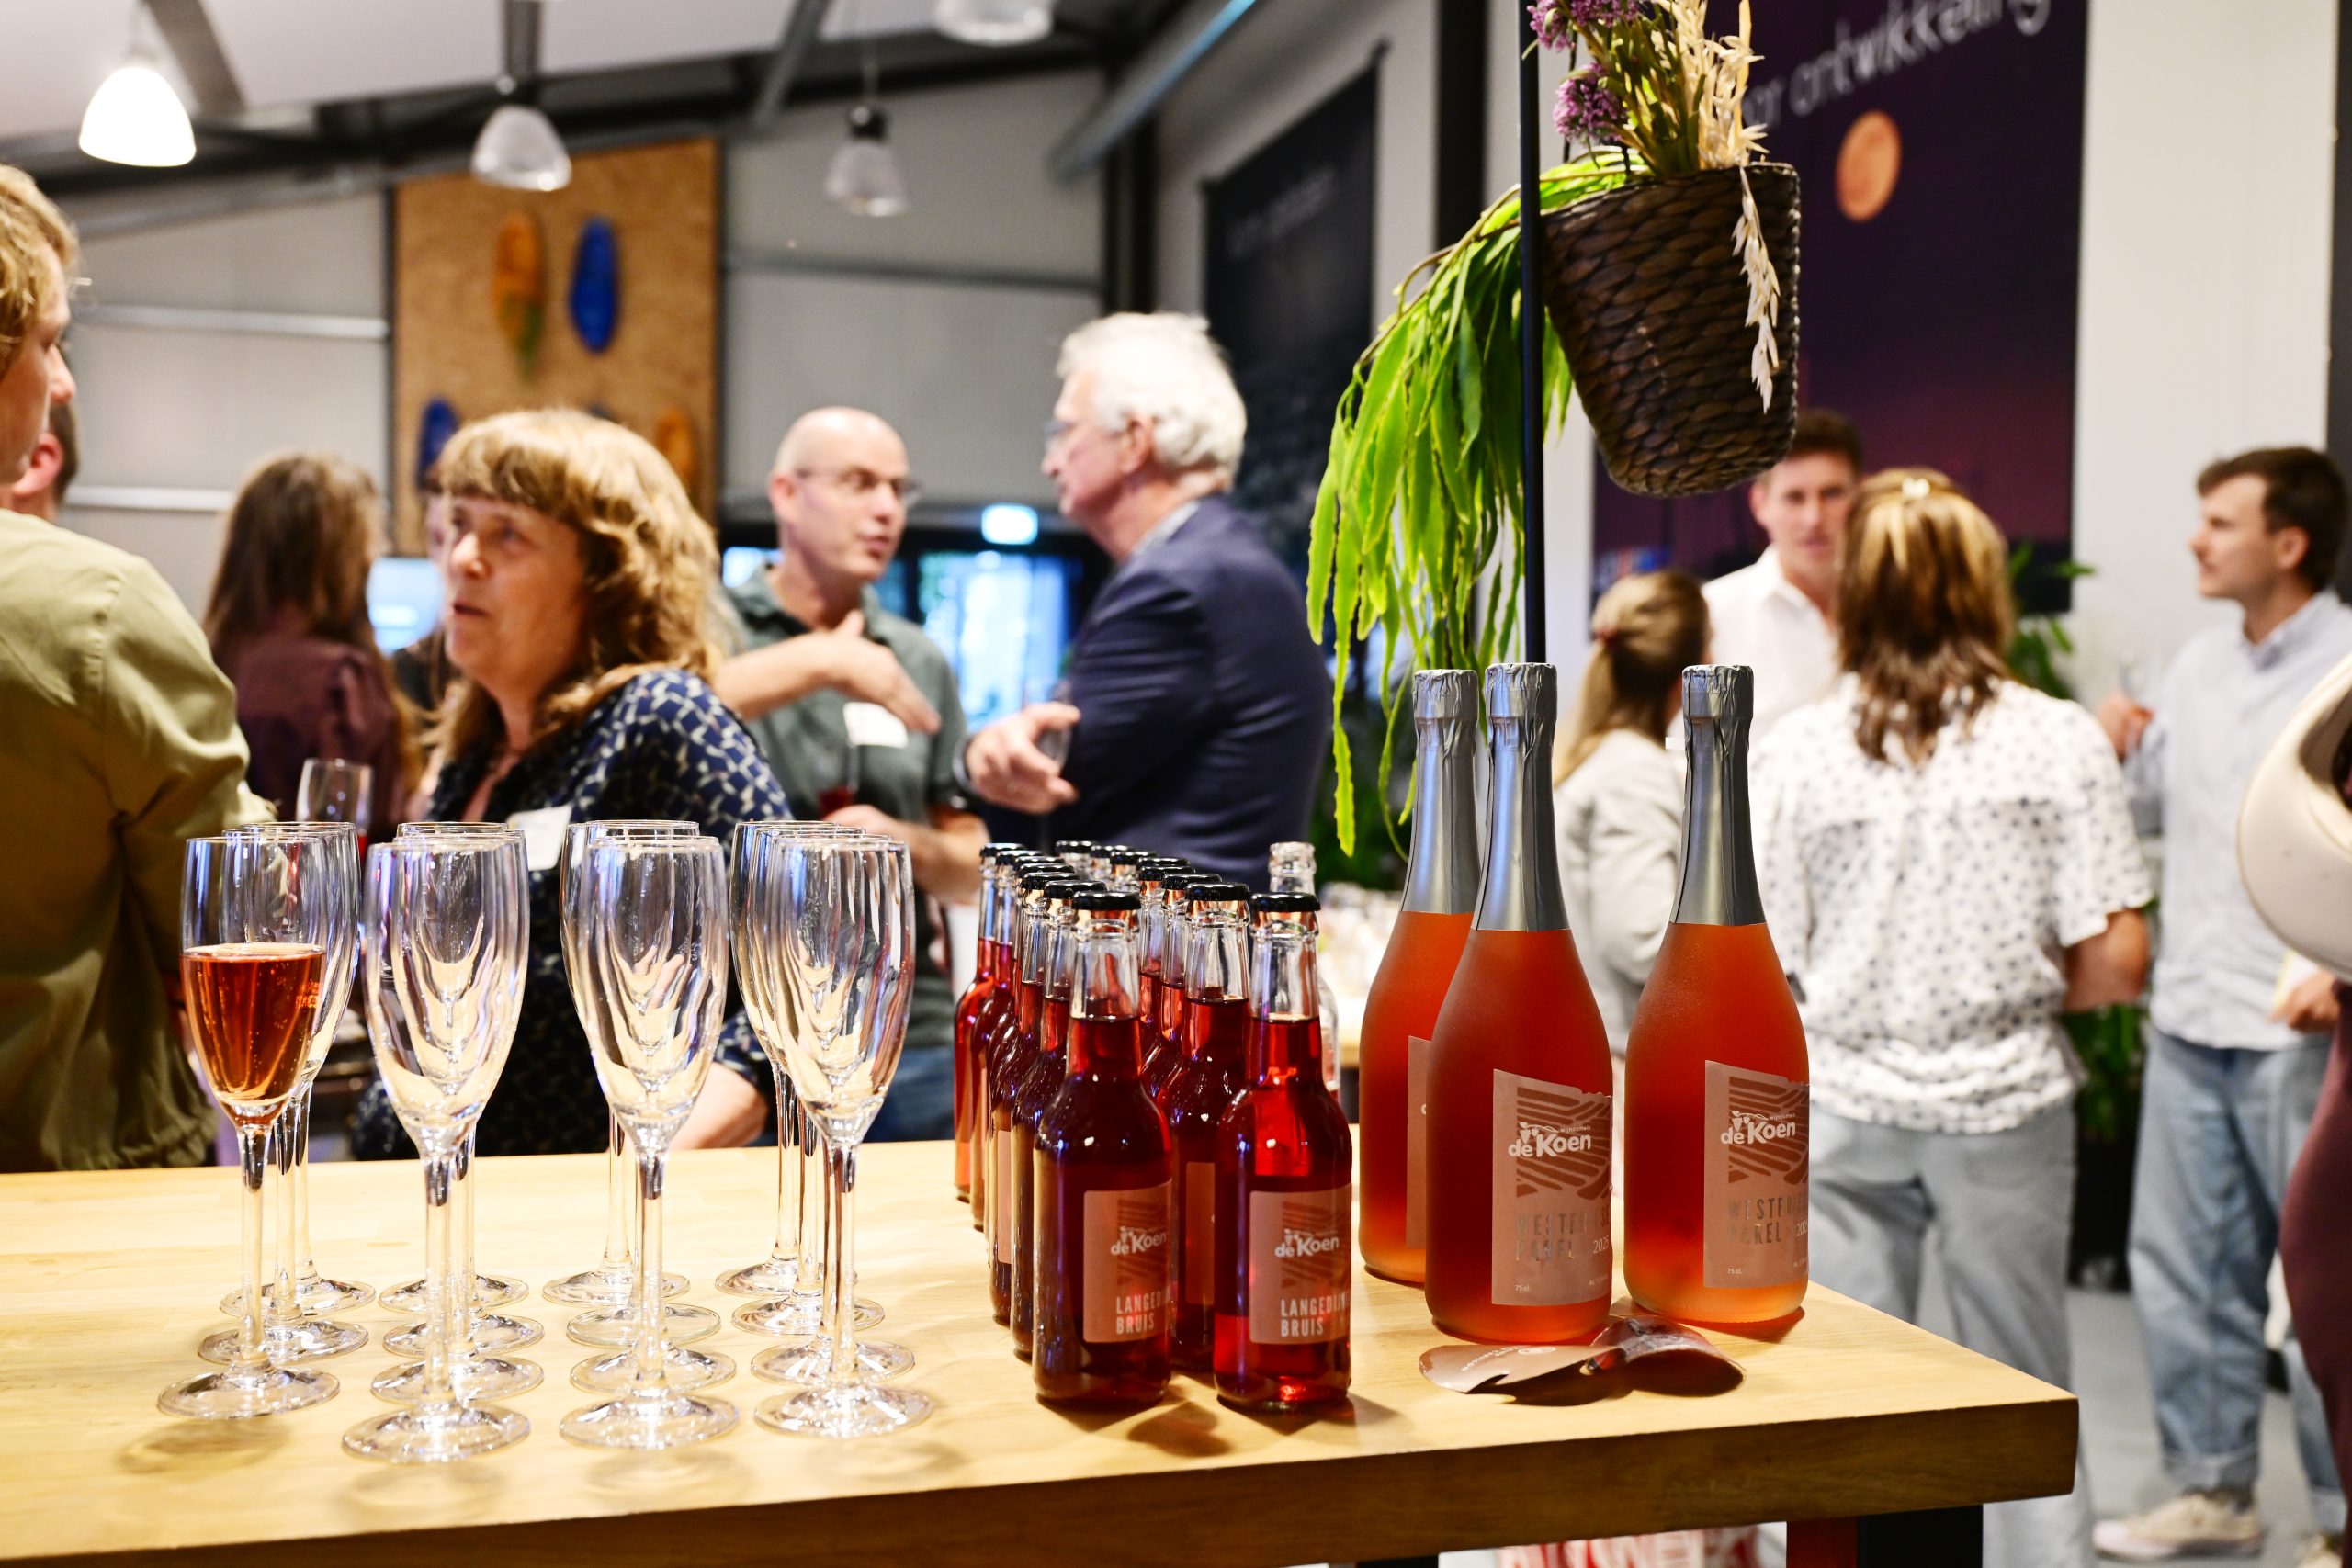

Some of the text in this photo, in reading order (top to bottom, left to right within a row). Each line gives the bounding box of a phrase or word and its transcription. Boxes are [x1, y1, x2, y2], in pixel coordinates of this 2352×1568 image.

[1720, 1121, 1796, 1145] de Koen
[1508, 1134, 1591, 1157] de Koen
[1110, 1232, 1167, 1256] de Koen
[1274, 1236, 1340, 1258] de Koen
[1116, 1313, 1155, 1335] BRUIS
[1281, 1316, 1324, 1337] BRUIS
